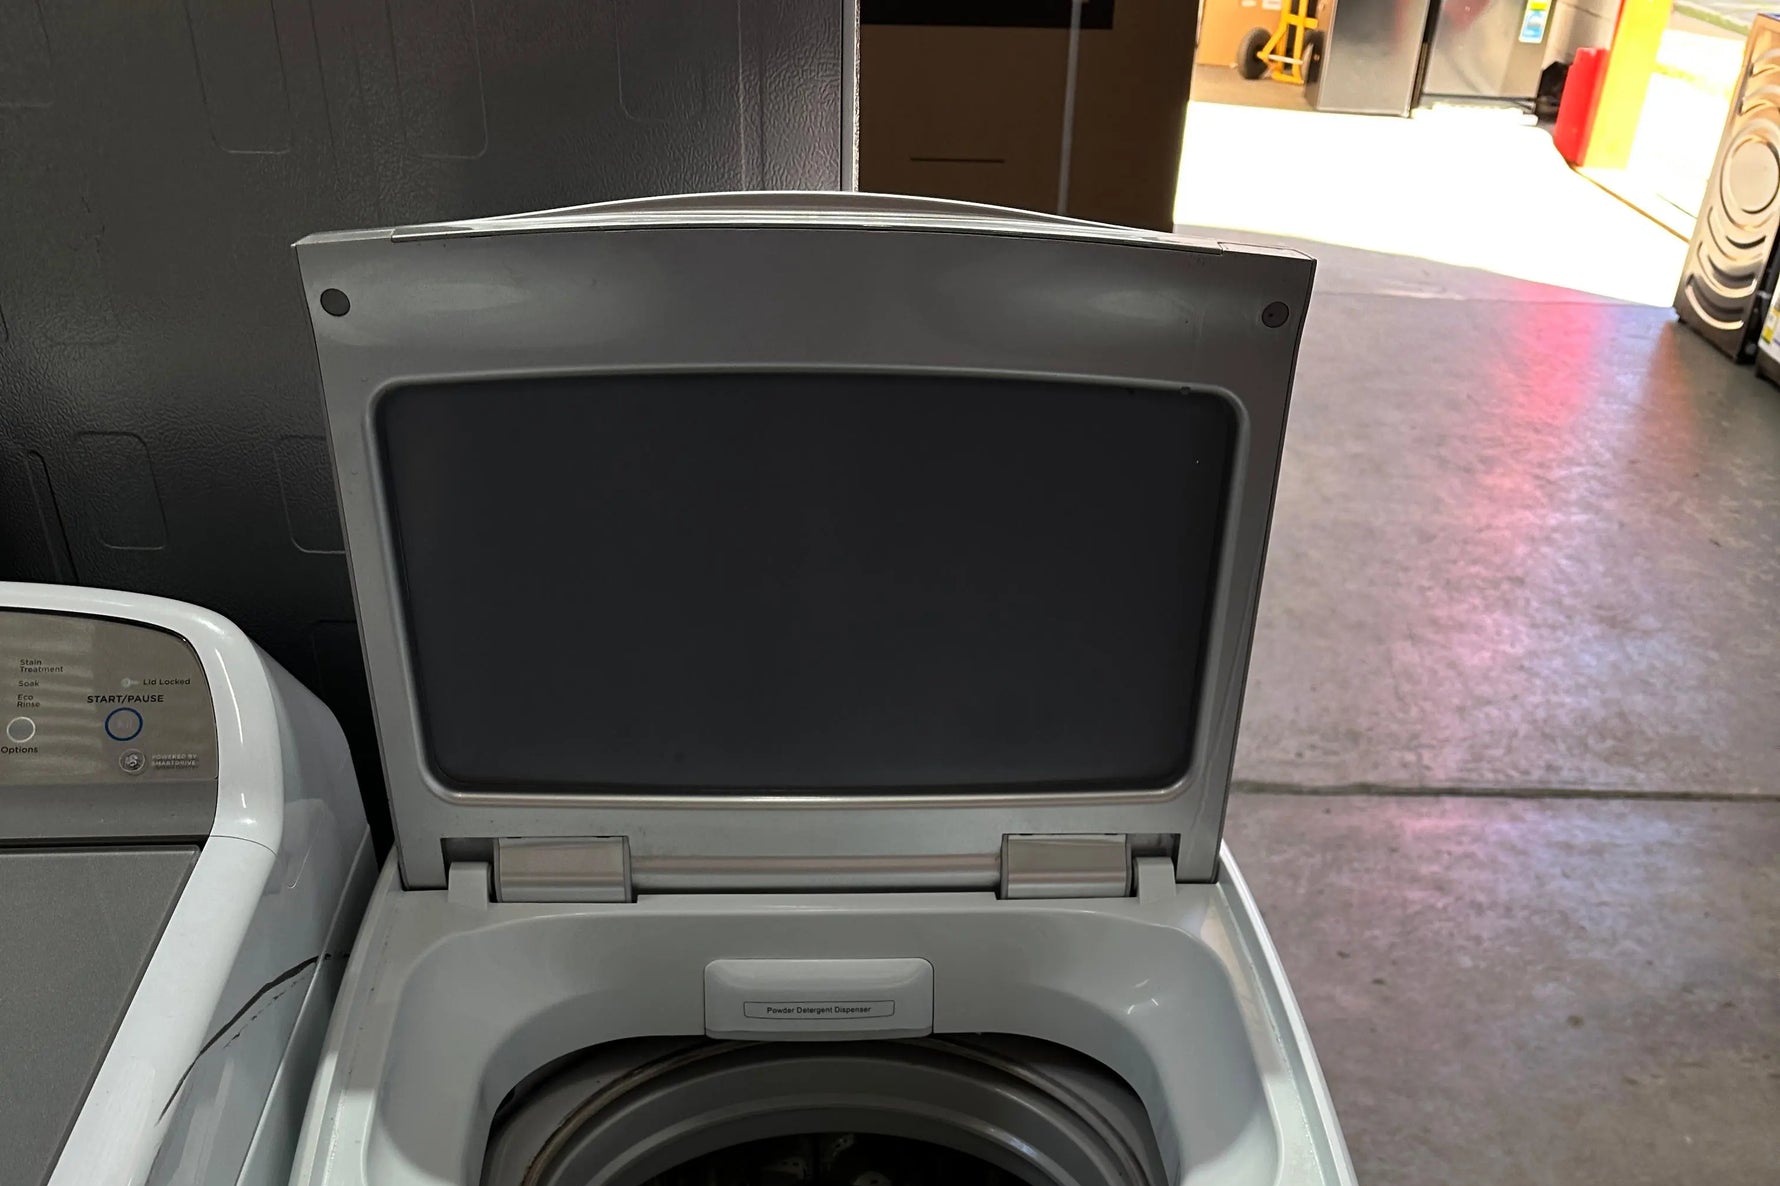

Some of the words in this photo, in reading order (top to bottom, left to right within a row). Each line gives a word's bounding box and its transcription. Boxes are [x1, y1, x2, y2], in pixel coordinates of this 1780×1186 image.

[20, 665, 64, 673] Treatment
[143, 678, 157, 686] Lid
[159, 678, 191, 686] Locked
[17, 693, 34, 701] Eco
[87, 694, 164, 704] START/PAUSE
[0, 746, 38, 755] Options
[766, 1006, 795, 1015] Powder
[796, 1006, 833, 1015] Detergent
[834, 1006, 872, 1015] Dispenser
